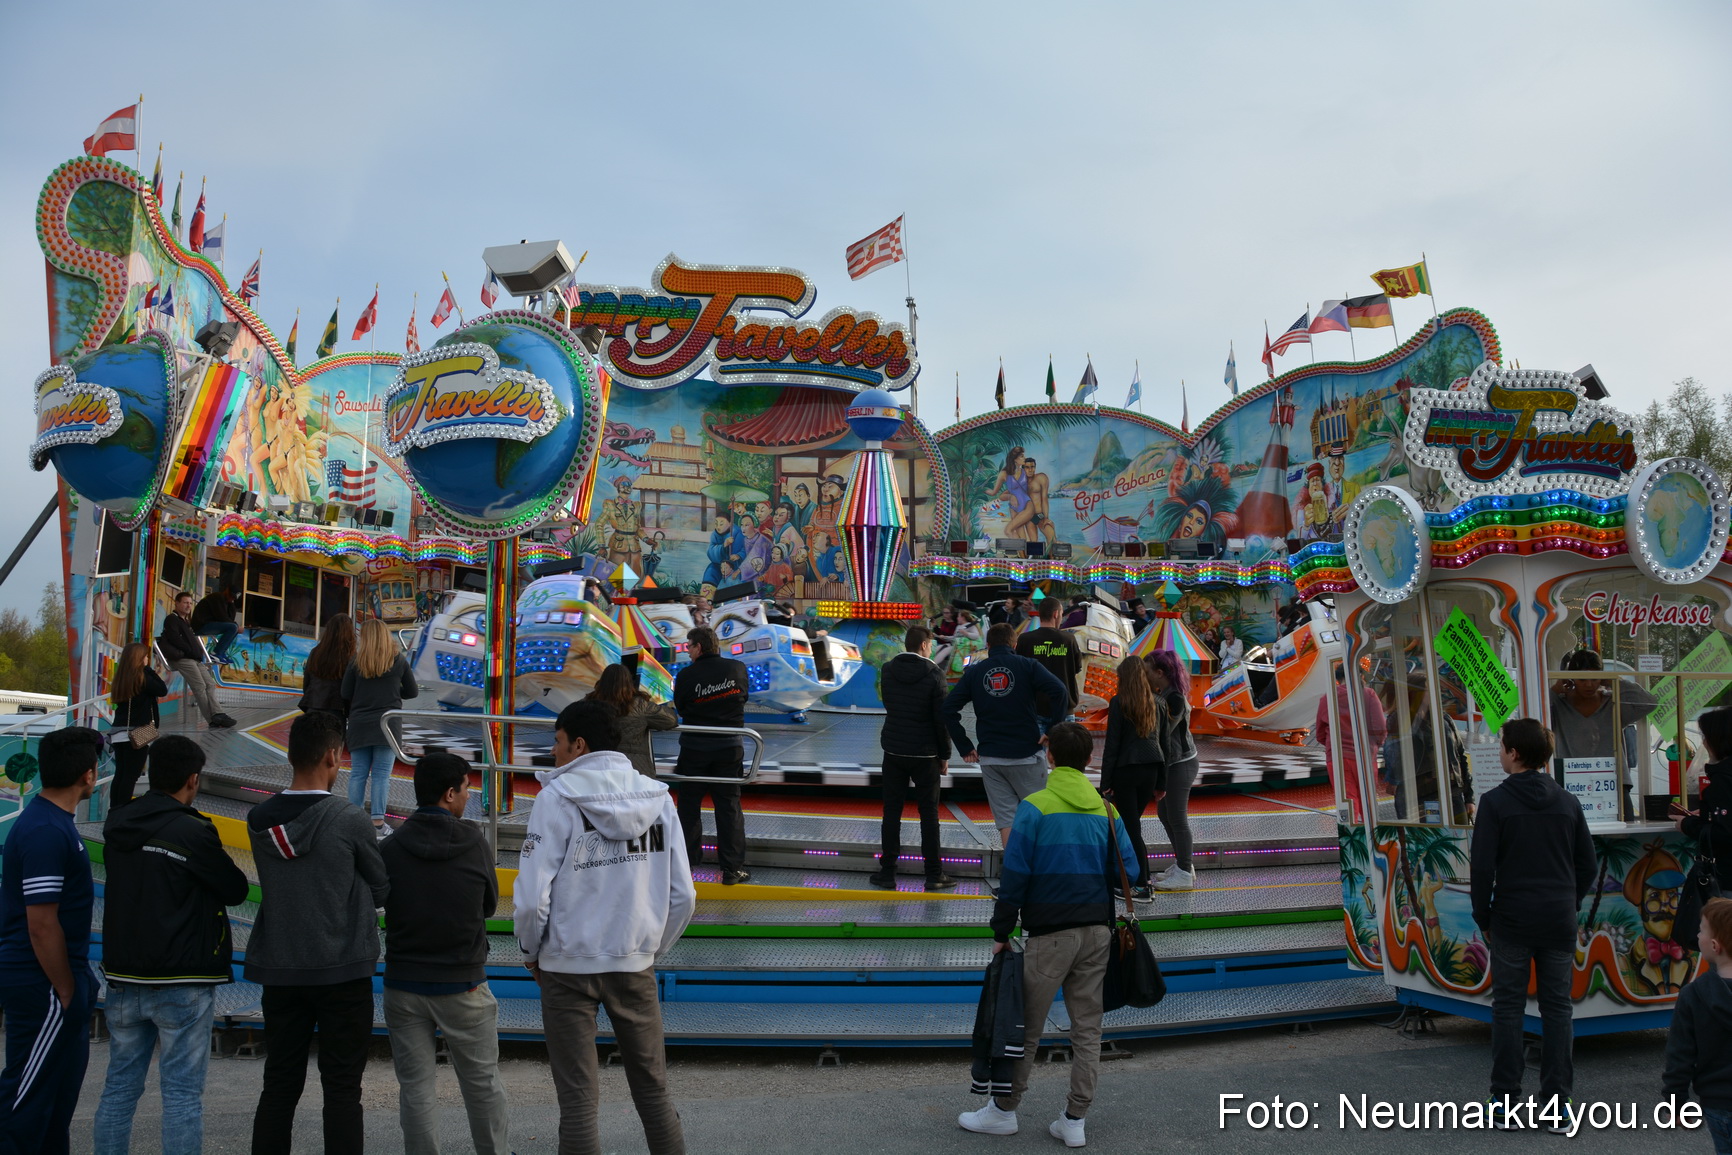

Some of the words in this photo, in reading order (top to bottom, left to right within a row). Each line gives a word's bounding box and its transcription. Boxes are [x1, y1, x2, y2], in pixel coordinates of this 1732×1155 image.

[608, 262, 911, 378] Traveller
[390, 356, 546, 443] Traveller
[1459, 382, 1638, 483] Traveller
[1073, 491, 1112, 512] Copa
[1113, 468, 1166, 497] Cabana
[1584, 591, 1712, 637] Chipkasse
[1445, 623, 1509, 716] Familienachmittag
[1449, 655, 1469, 681] halbe
[1458, 619, 1489, 663] Samstag
[1485, 660, 1512, 694] großer
[695, 678, 736, 697] Intruder
[1566, 782, 1586, 792] Kinder
[1595, 780, 1616, 792] 2.50
[1571, 761, 1592, 770] Fahrchips
[573, 856, 618, 871] UNDERGROUND
[619, 853, 648, 864] EASTSIDE
